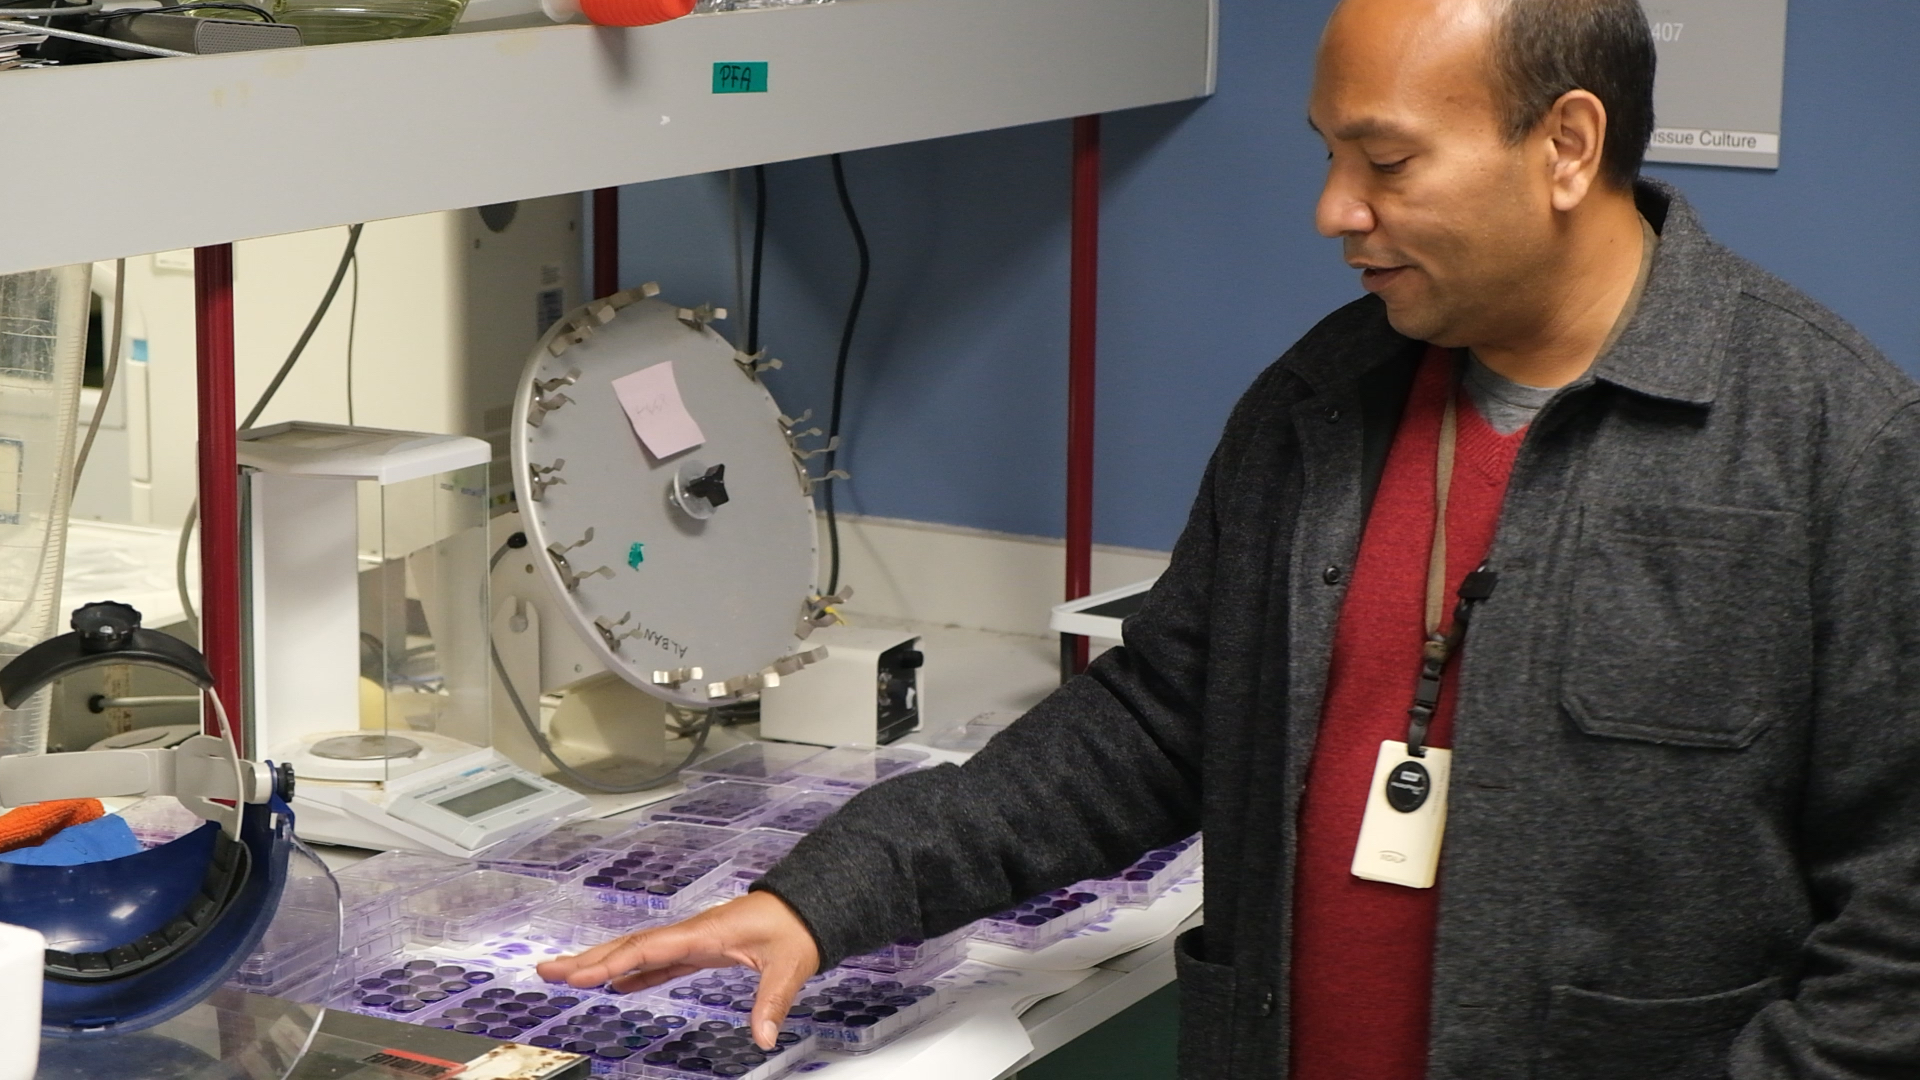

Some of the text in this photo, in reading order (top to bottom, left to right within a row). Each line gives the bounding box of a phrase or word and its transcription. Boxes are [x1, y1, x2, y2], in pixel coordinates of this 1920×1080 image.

[720, 65, 751, 91] PFA
[1652, 130, 1757, 149] issue Culture
